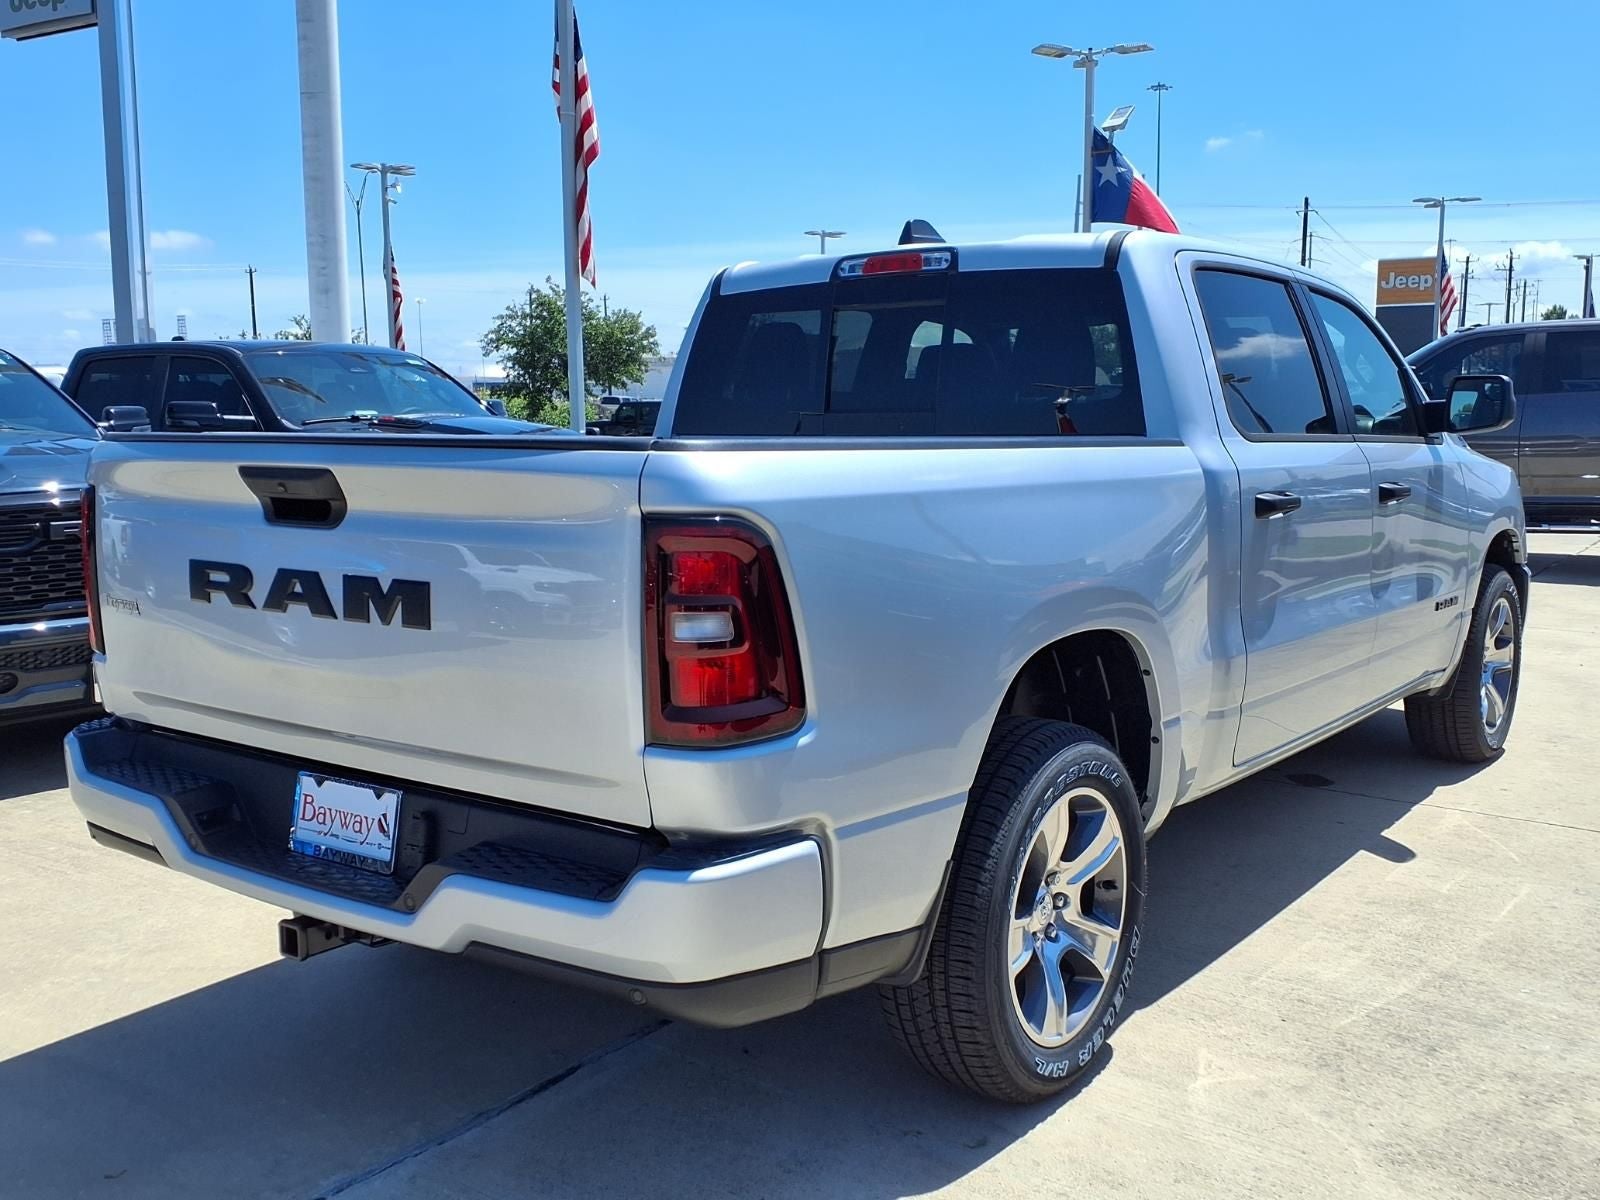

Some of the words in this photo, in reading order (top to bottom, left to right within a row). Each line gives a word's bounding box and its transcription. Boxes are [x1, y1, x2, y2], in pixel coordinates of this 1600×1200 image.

[1381, 271, 1433, 291] Jeep
[188, 558, 432, 631] RAM
[299, 792, 375, 846] Bayway
[313, 844, 366, 866] BAYWAY
[1079, 926, 1141, 1066] DUELER
[1035, 1057, 1070, 1077] H/L
